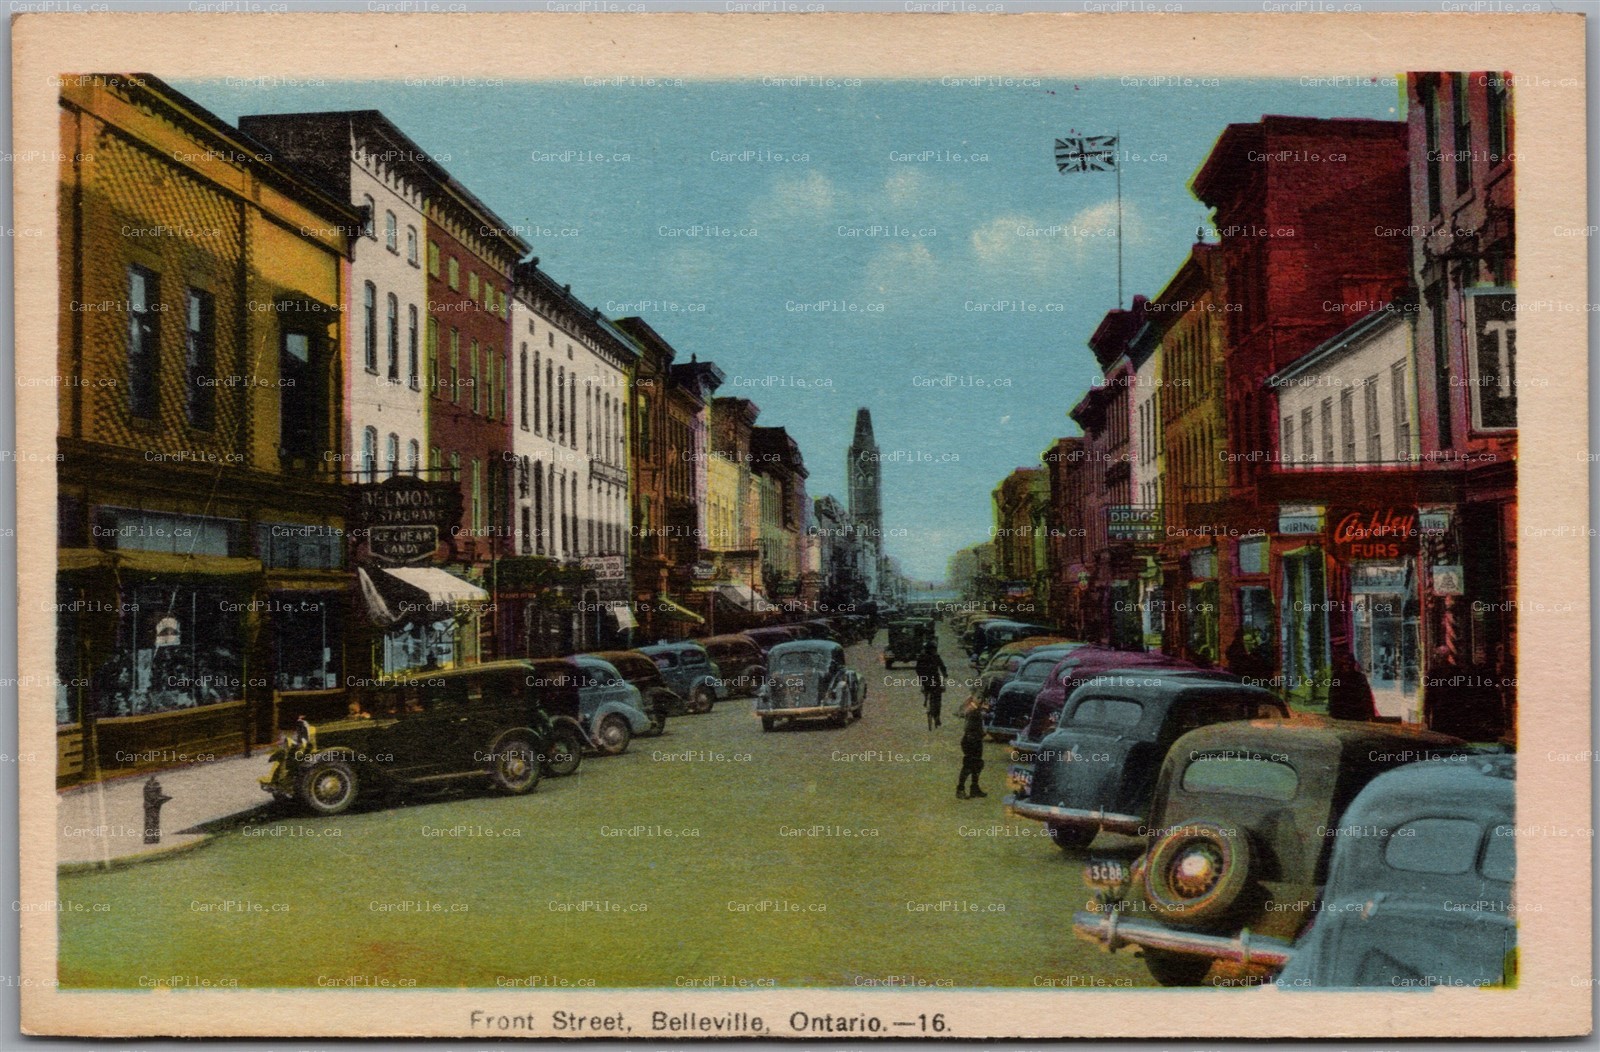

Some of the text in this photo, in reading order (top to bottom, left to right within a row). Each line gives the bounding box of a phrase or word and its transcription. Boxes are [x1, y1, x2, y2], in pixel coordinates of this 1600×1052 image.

[1110, 511, 1159, 522] DRUGS
[1334, 508, 1414, 544] Ashley
[384, 543, 419, 554] CANDY
[1350, 543, 1399, 558] FURS
